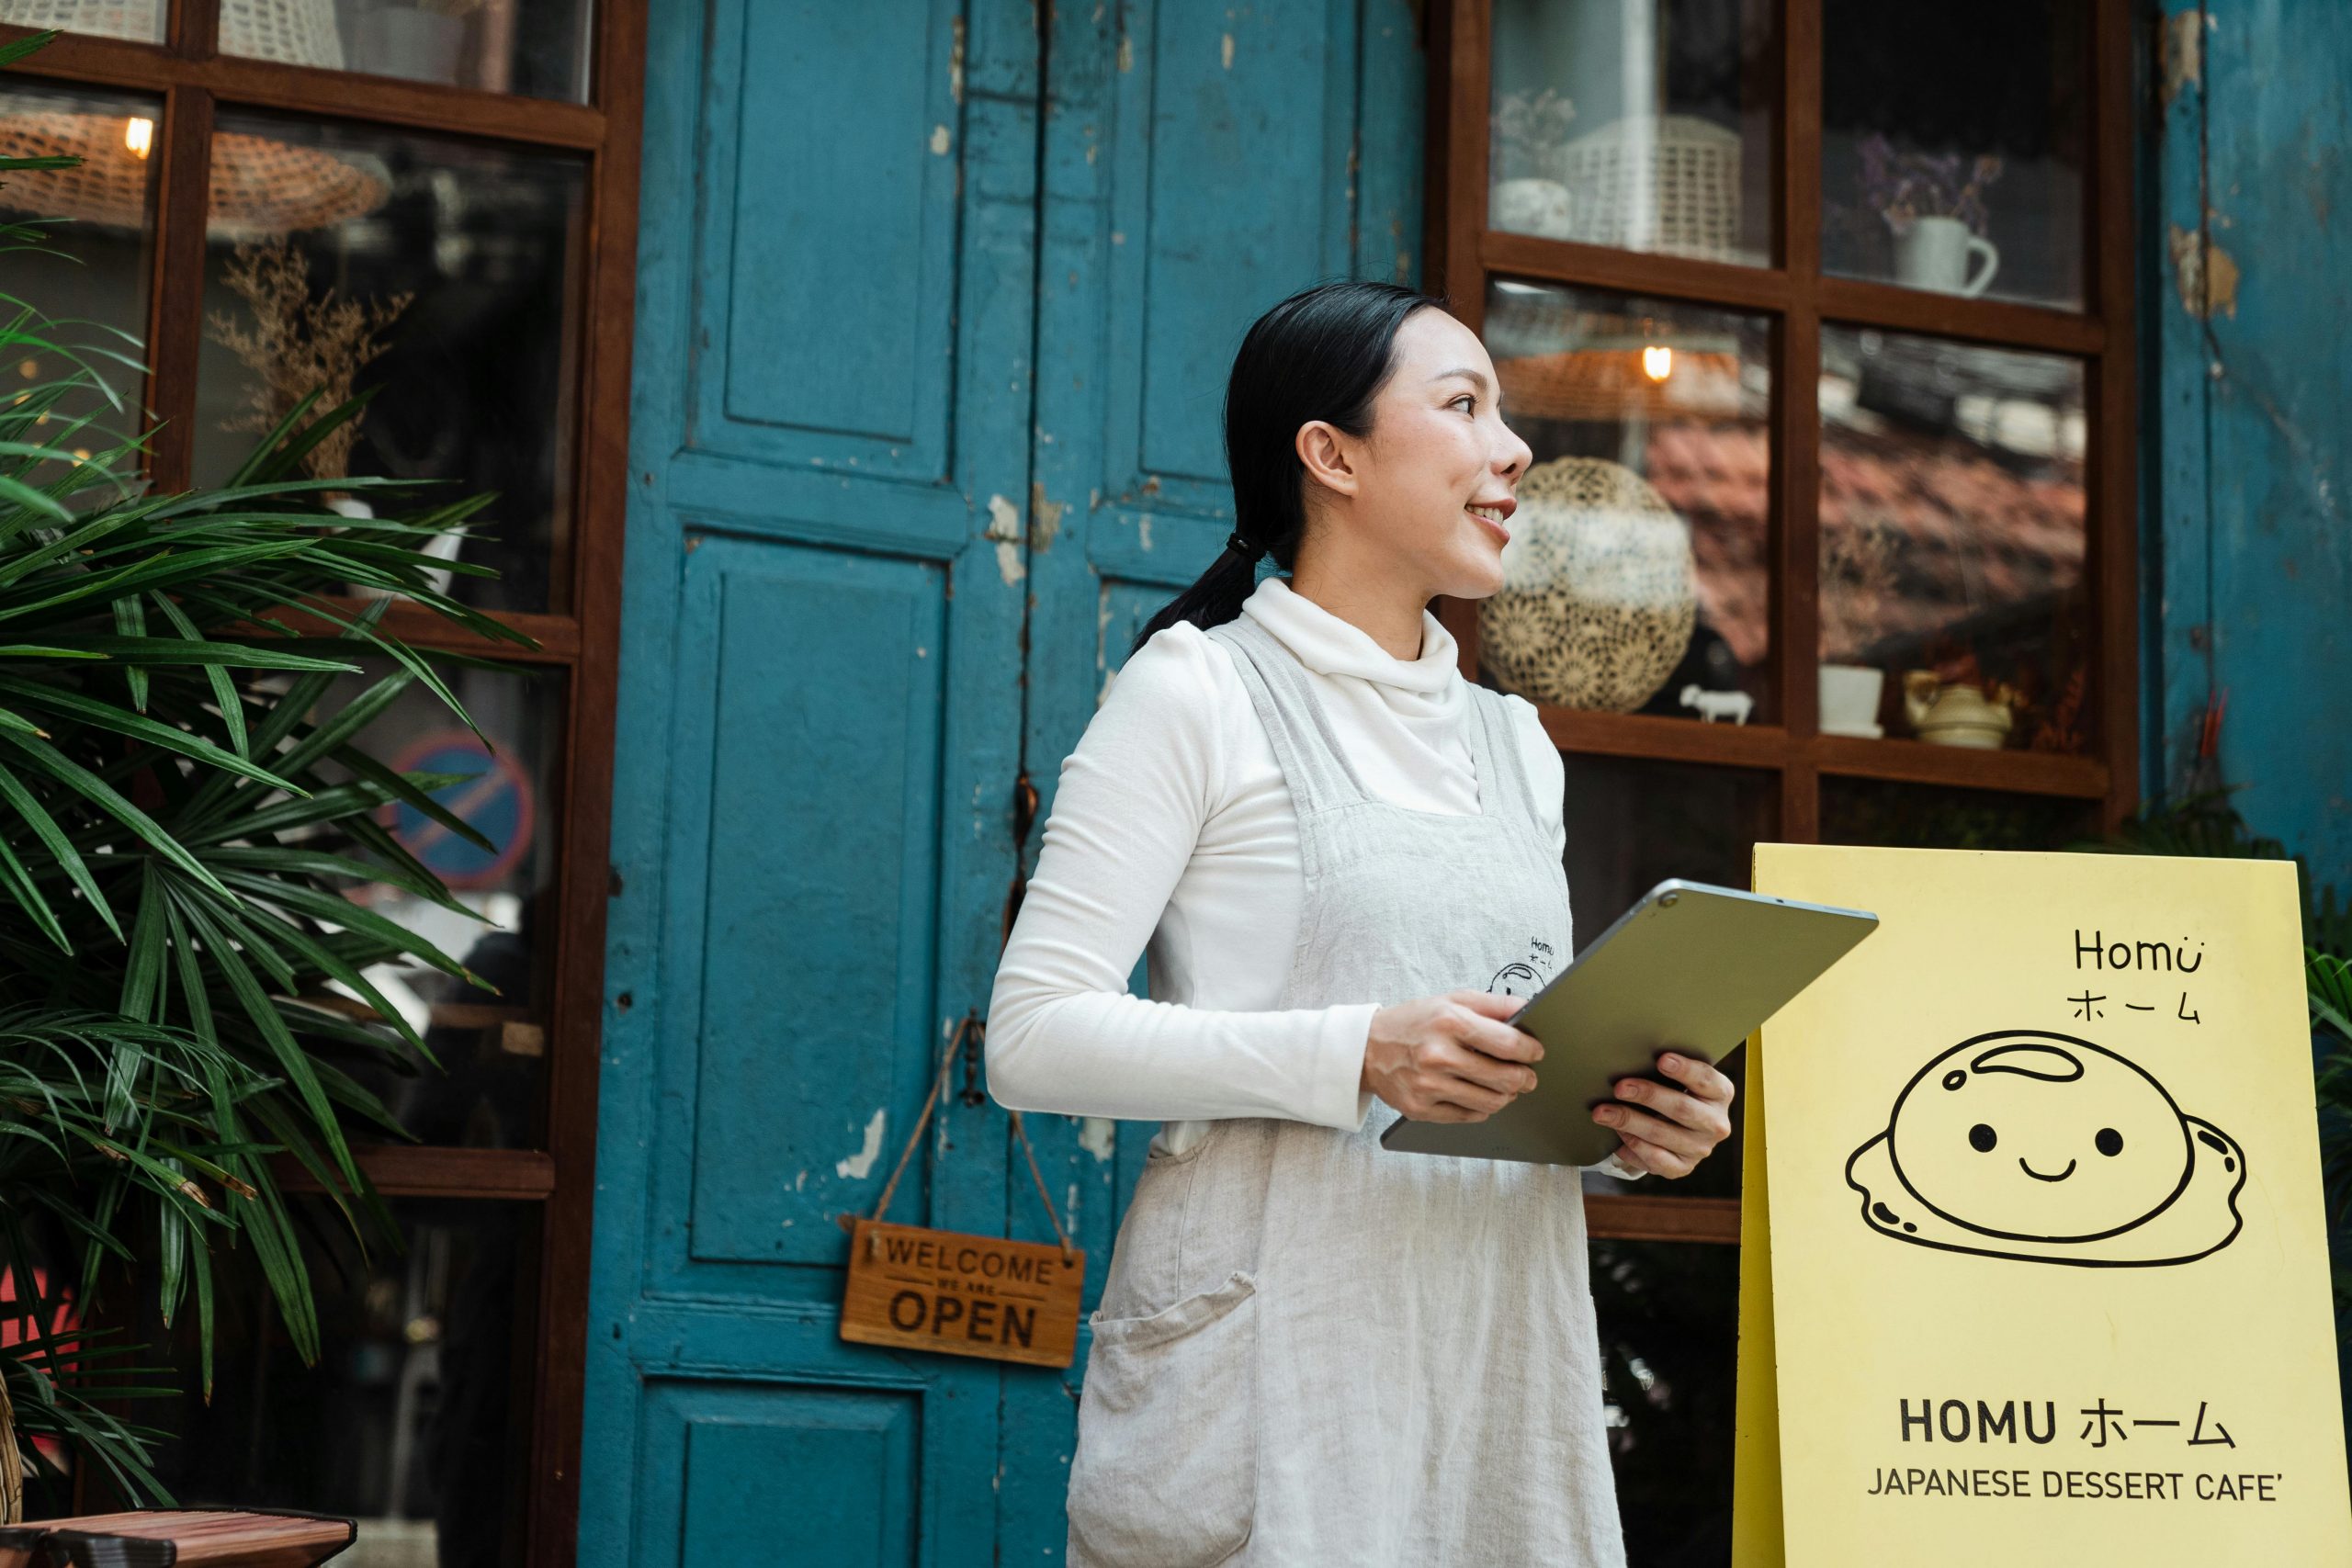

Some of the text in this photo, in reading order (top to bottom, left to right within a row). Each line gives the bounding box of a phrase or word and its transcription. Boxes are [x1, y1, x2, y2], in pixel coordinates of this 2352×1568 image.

[2066, 989, 2201, 1025] ホーム
[886, 1236, 1054, 1285] WELCOME
[937, 1278, 996, 1297] WE ARE
[888, 1290, 1035, 1348] OPEN
[1899, 1397, 2237, 1450] HOMU ホーム
[1867, 1468, 2032, 1497] JAPANESE
[2041, 1470, 2185, 1500] DESSERT
